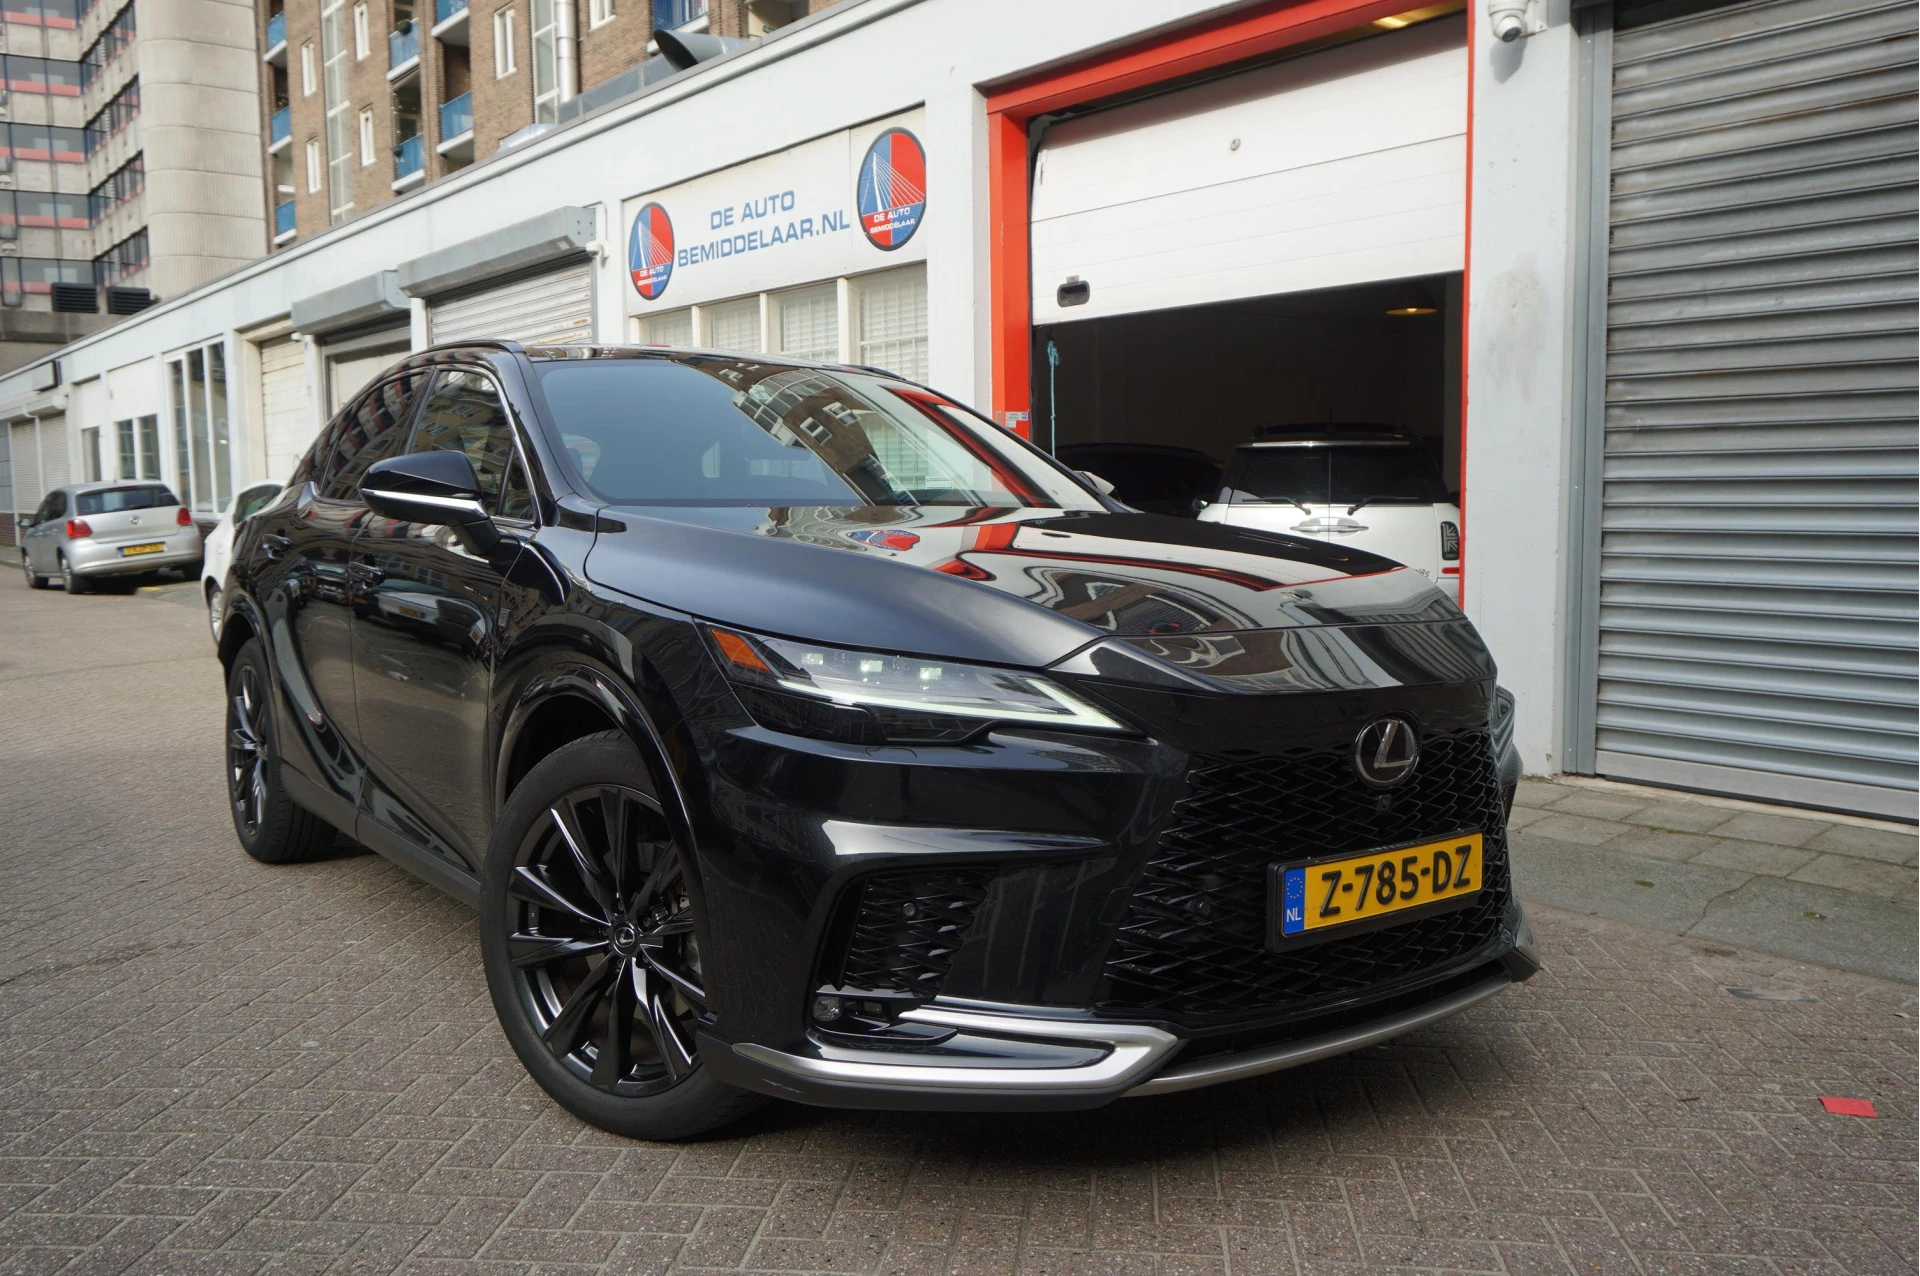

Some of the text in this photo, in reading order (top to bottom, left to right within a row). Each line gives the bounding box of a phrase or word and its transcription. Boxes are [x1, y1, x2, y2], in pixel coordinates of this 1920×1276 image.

[710, 190, 794, 230] DE AUTO
[873, 206, 911, 223] DE AUTO
[678, 209, 850, 267] BEMIDDELAAR.NL
[1319, 844, 1472, 918] Z-785-DZ
[1286, 907, 1302, 922] NL
